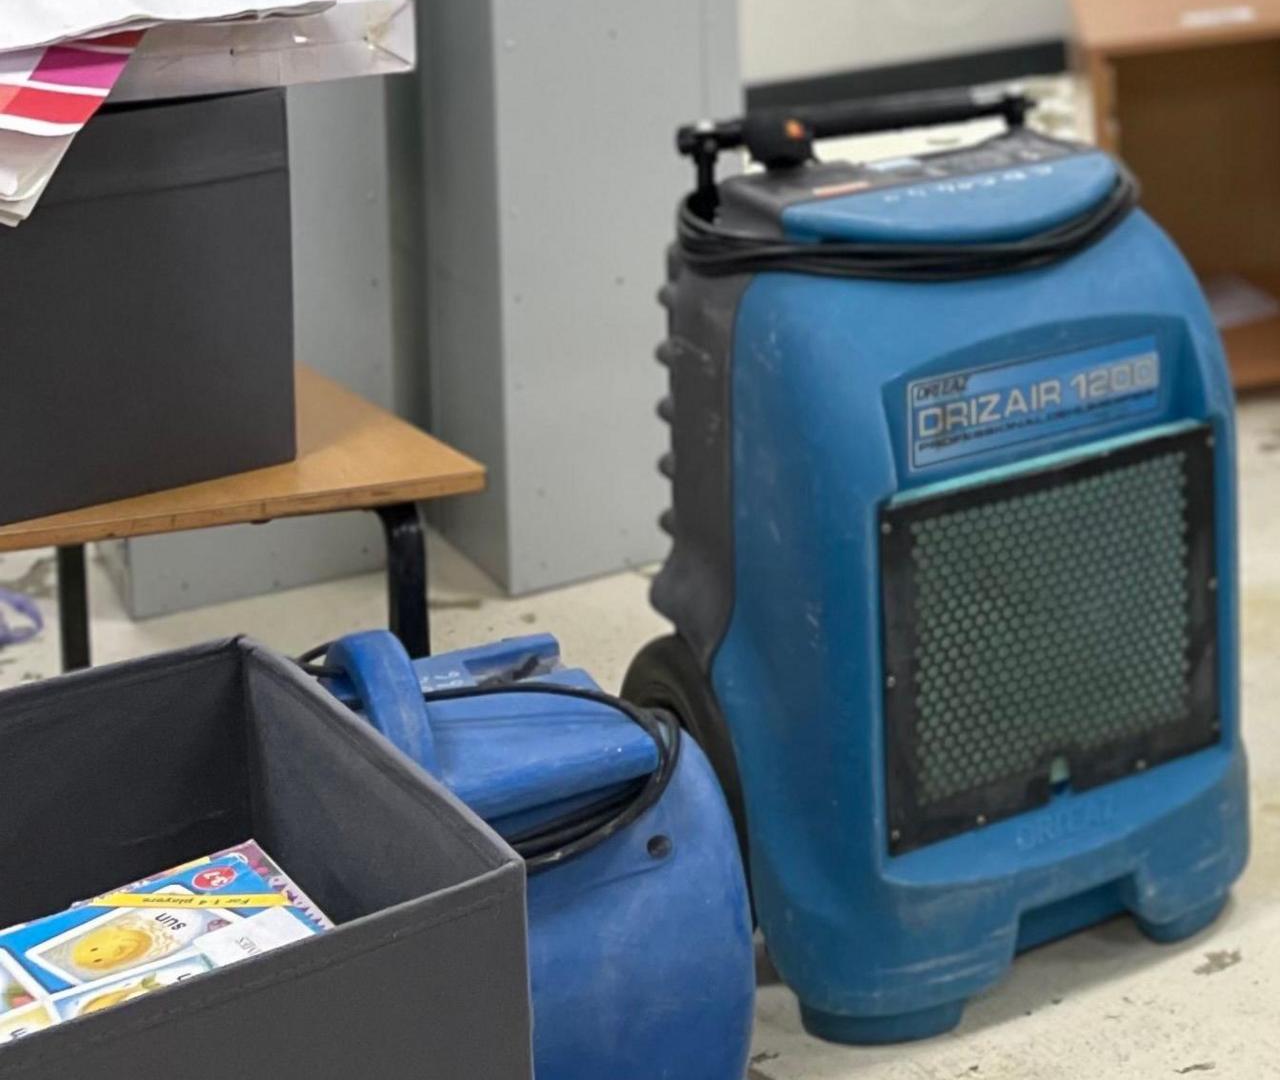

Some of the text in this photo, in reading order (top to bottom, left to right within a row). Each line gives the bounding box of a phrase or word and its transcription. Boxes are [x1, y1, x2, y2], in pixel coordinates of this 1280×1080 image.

[918, 379, 1061, 437] DRIZAIR
[1070, 355, 1157, 400] 1200
[154, 912, 187, 931] sun
